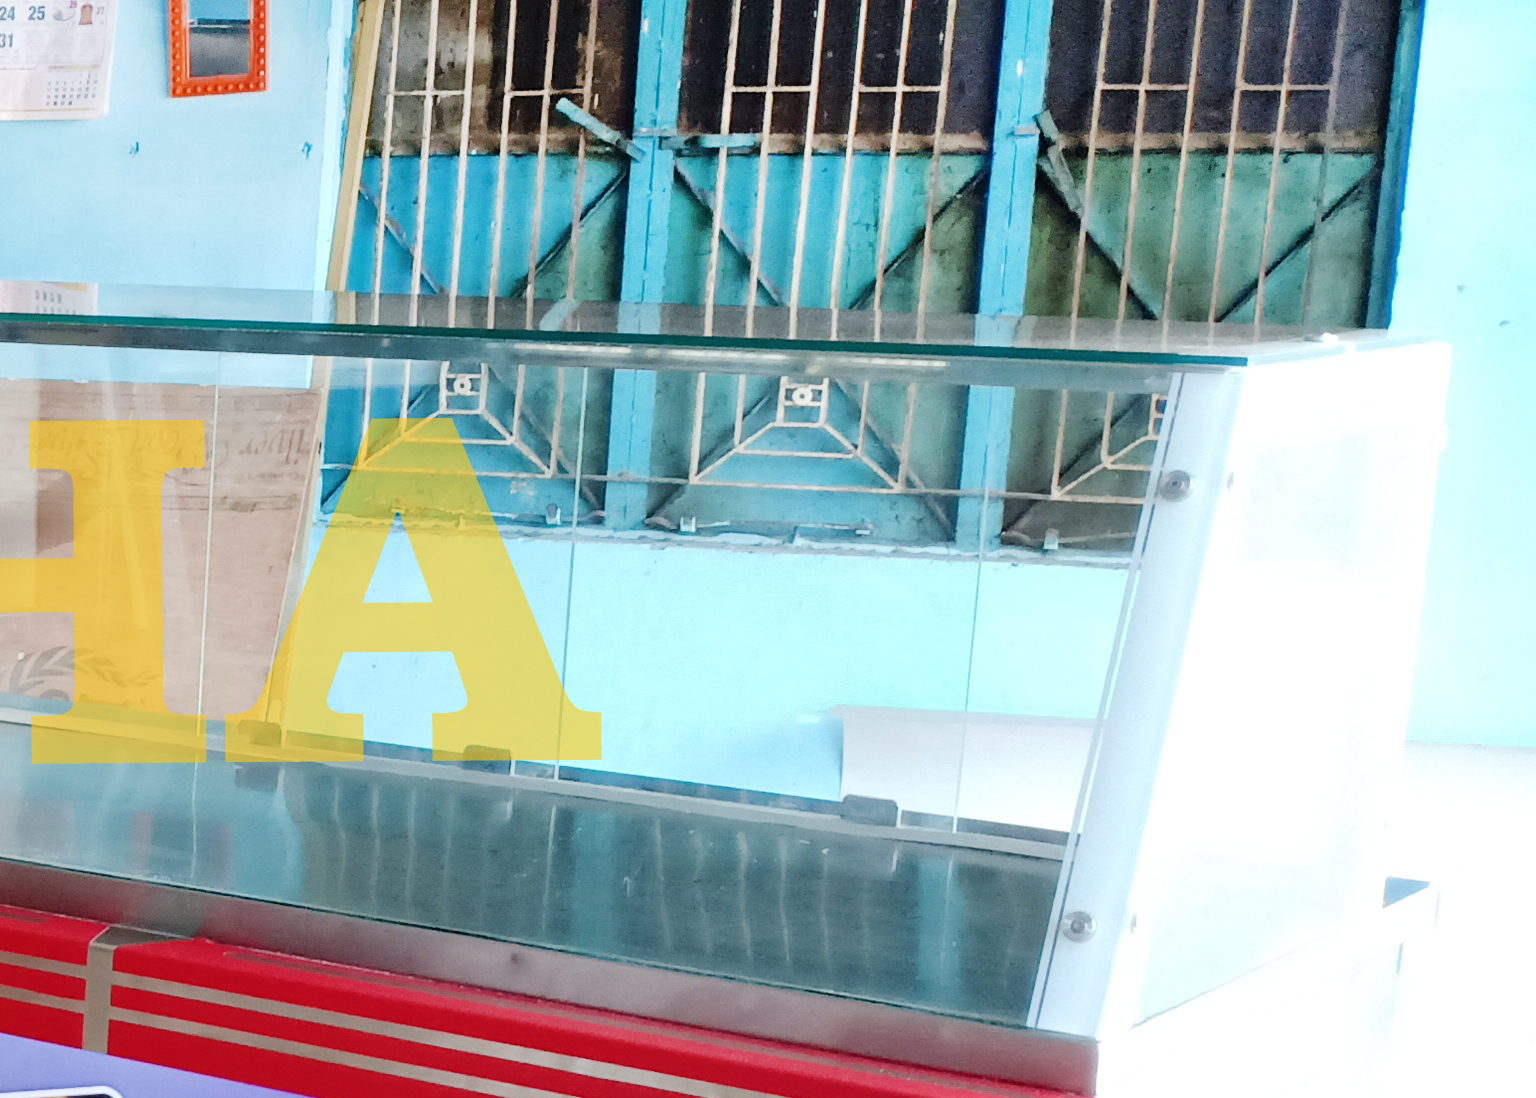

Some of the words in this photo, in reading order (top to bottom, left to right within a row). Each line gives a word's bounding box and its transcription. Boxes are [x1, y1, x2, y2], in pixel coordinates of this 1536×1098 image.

[0, 6, 16, 21] 24
[28, 6, 46, 20] 25
[96, 7, 105, 15] 27
